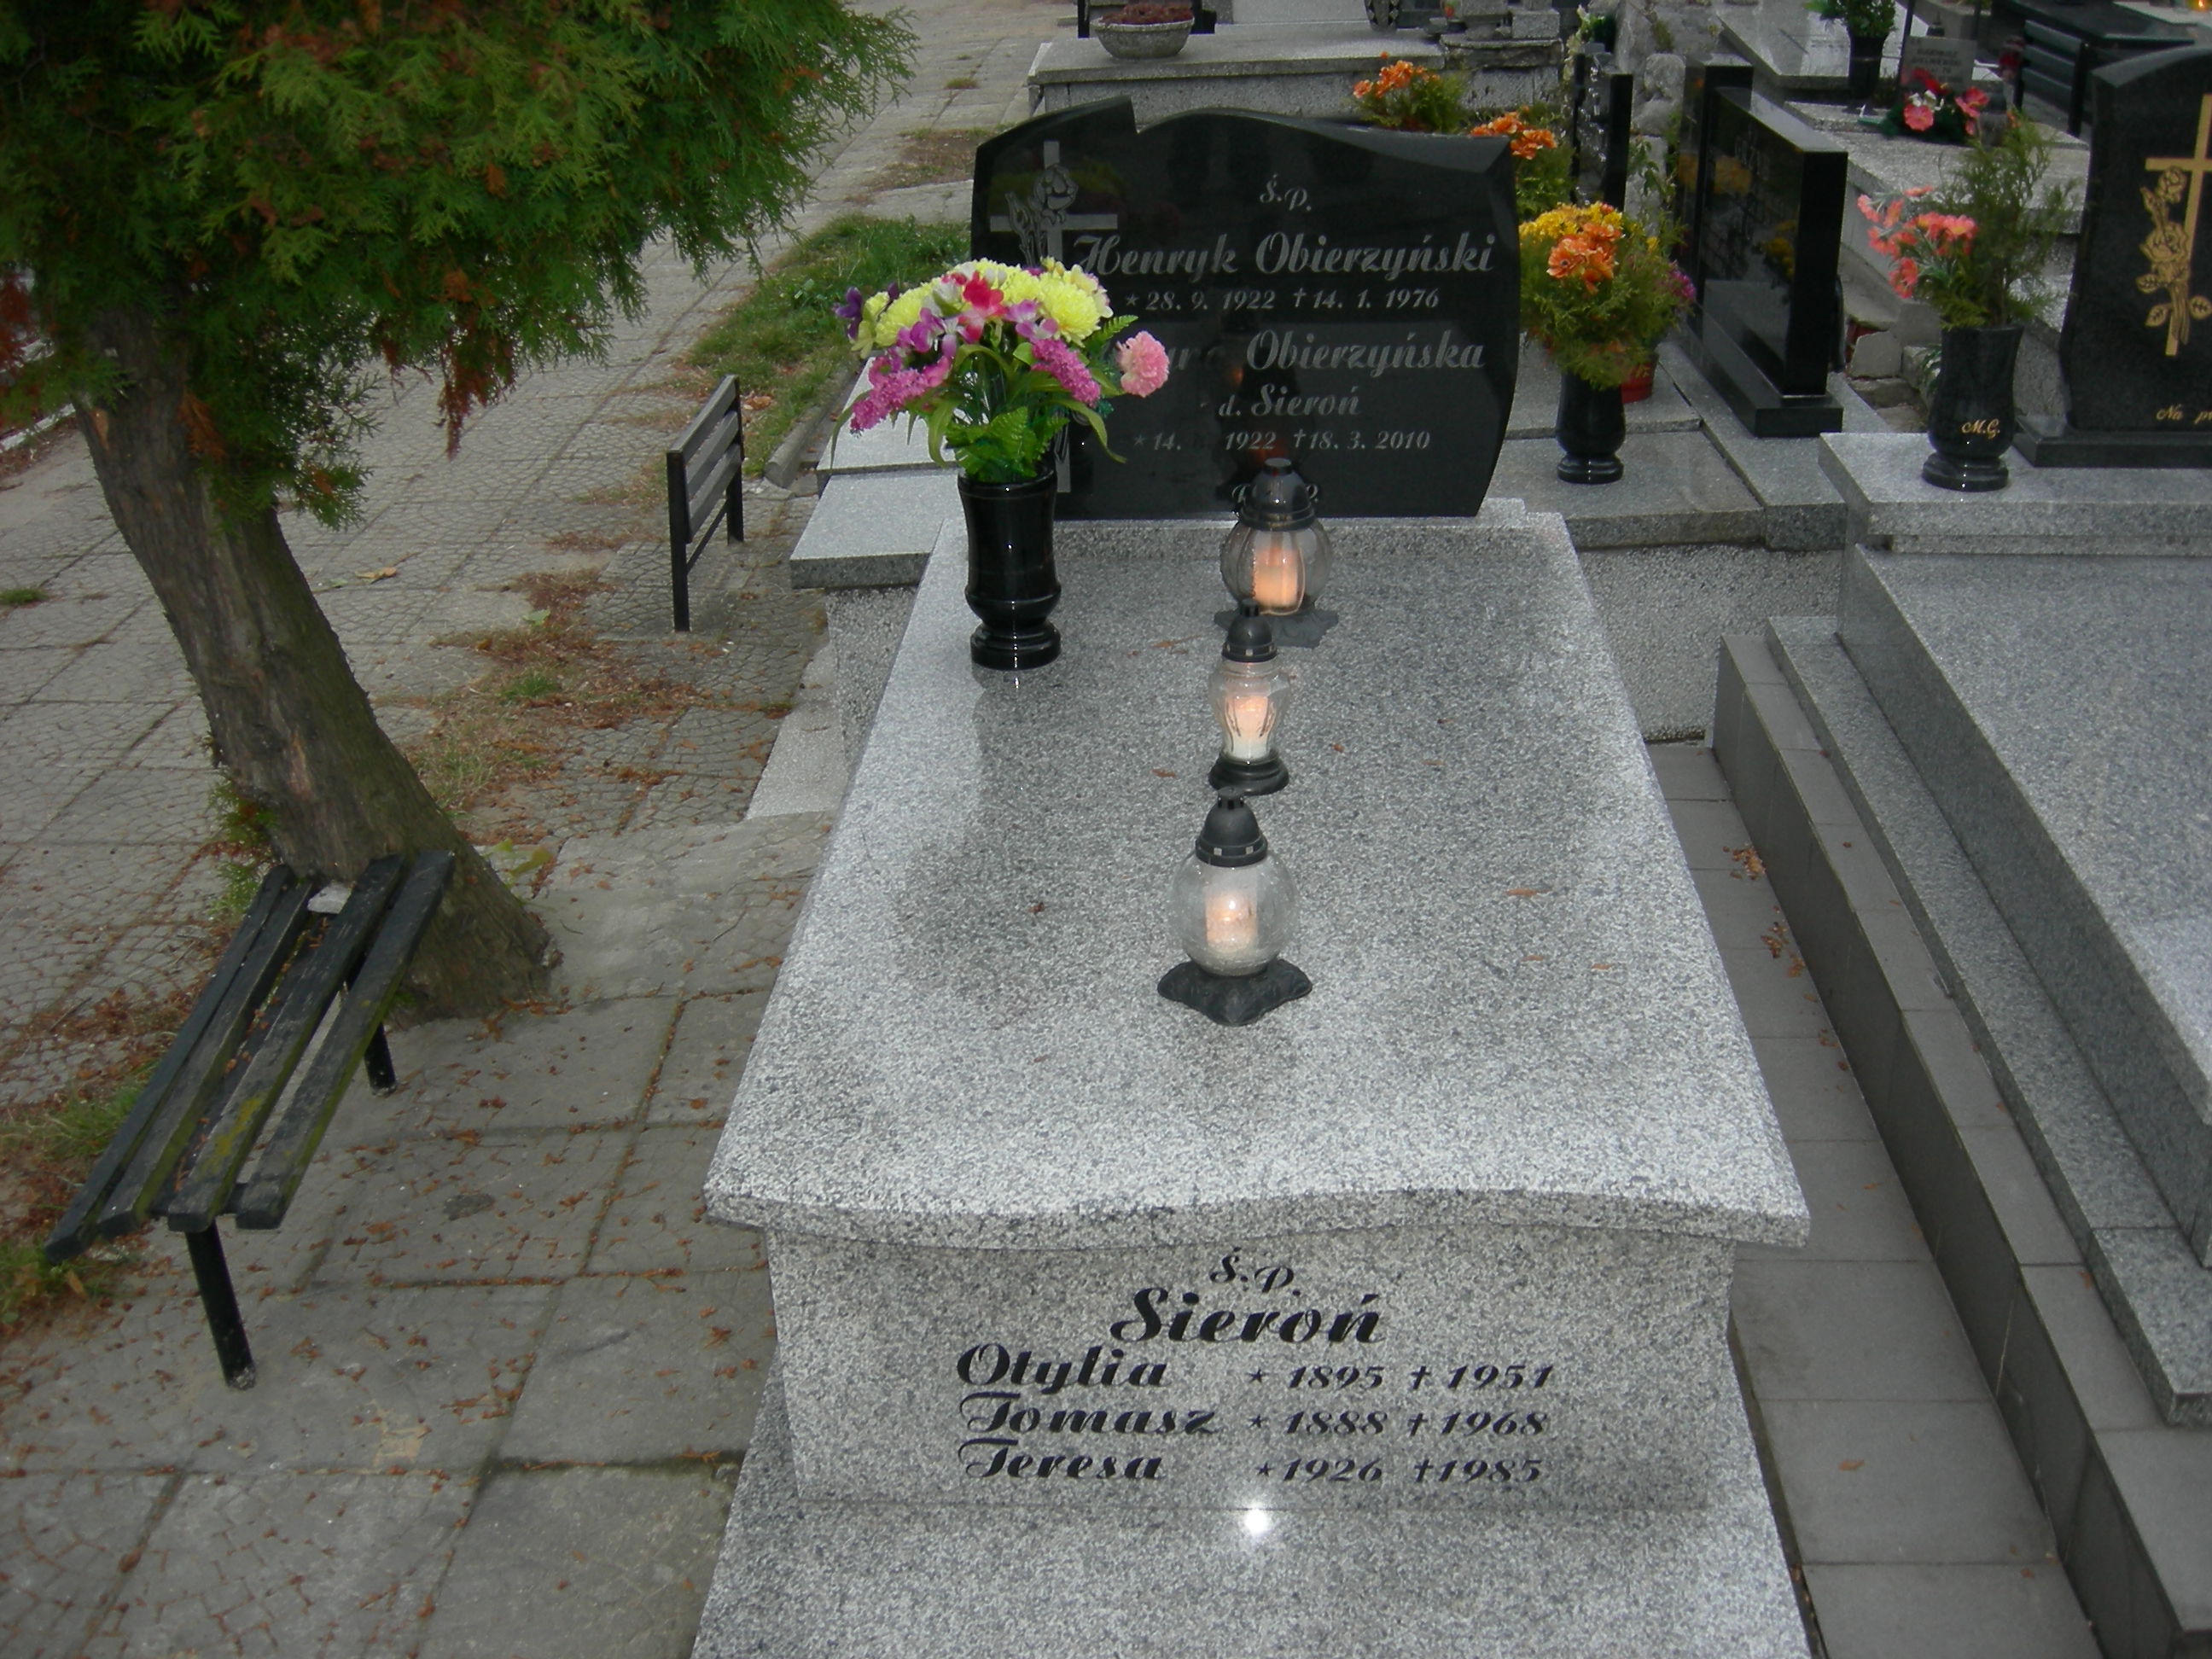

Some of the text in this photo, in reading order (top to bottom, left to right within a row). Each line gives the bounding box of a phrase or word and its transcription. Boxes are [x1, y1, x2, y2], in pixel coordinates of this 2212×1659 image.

[1073, 231, 1495, 283] Henryk Obierzyński
[1145, 290, 1181, 311] 28.
[1223, 288, 1276, 311] 1922
[1386, 287, 1440, 310] 1976
[1246, 329, 1487, 377] Obierzyńska
[1218, 383, 1363, 416] d. Sieroń
[1224, 430, 1278, 451] 1922
[1374, 429, 1431, 451] 2010
[1109, 1286, 1385, 1344] Sieroń
[957, 1342, 1553, 1395] Otylia 1895 1951
[958, 1391, 1548, 1437] Tomasz 1888 1968
[958, 1437, 1541, 1484] Teresa 1926 1985
